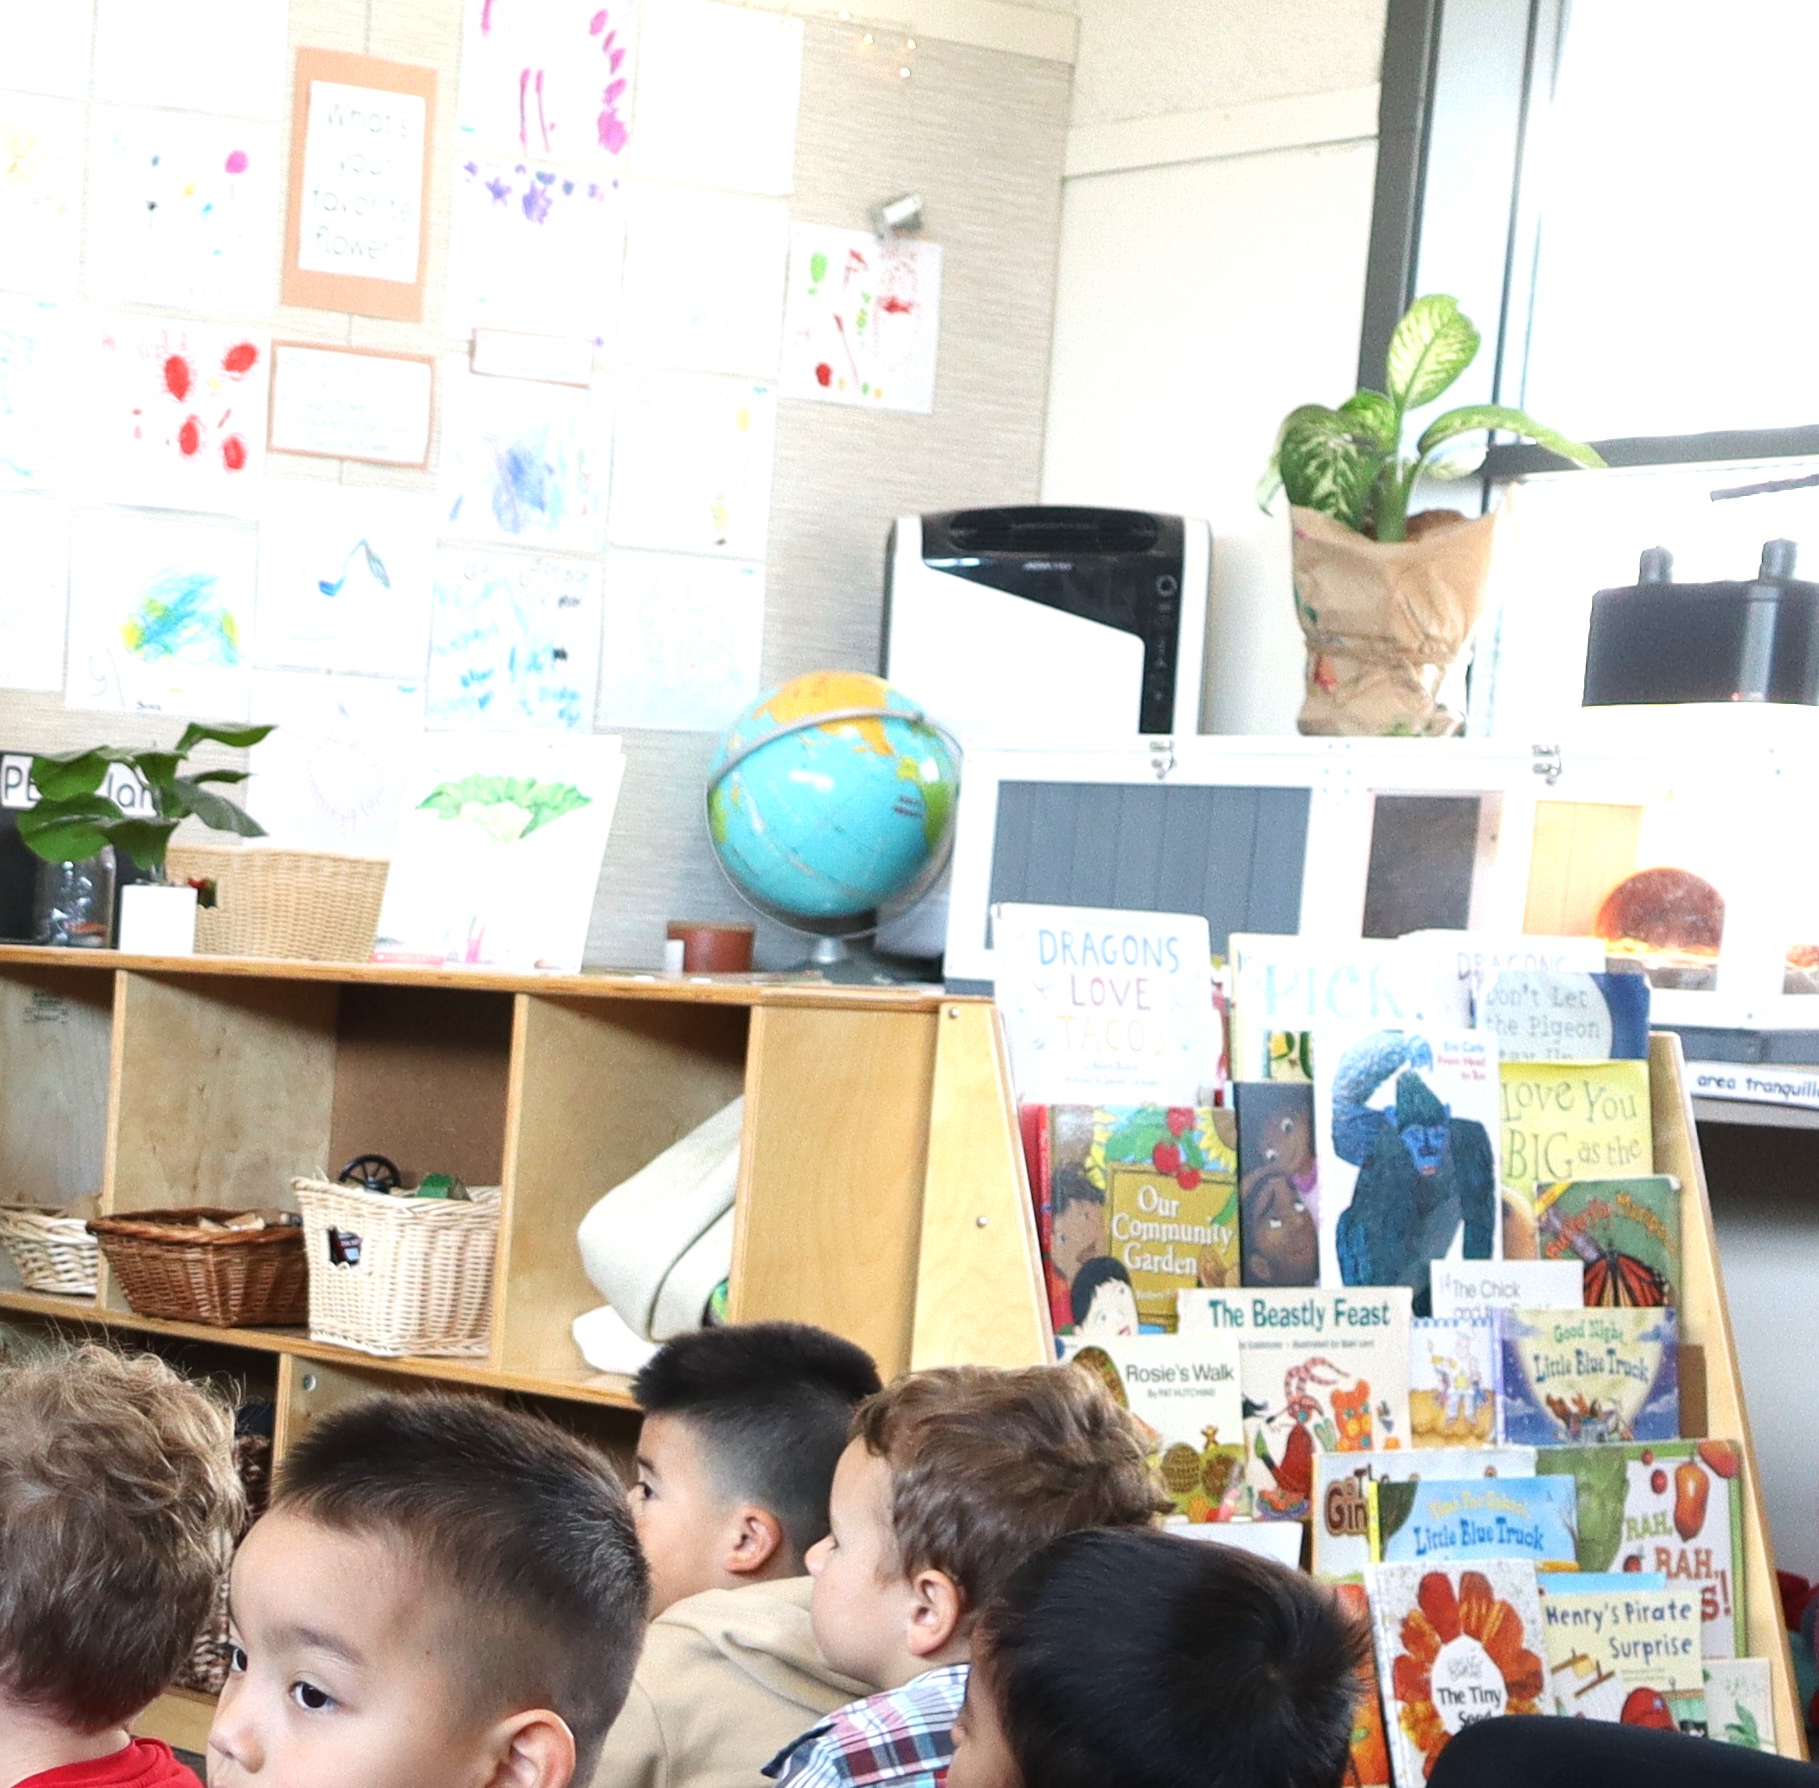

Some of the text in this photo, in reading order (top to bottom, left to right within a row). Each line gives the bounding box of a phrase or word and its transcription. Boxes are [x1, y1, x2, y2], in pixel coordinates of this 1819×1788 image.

[1038, 928, 1180, 974] DRAGONS
[1071, 974, 1151, 1011] LOVE
[1549, 985, 1588, 1008] Let
[1529, 1014, 1601, 1044] Pigeon
[1697, 1074, 1736, 1090] area
[1501, 1079, 1638, 1122] Love You
[1506, 1128, 1642, 1180] BIG as the
[1137, 1186, 1181, 1217] Our
[1112, 1213, 1233, 1252] Community
[1123, 1244, 1198, 1276] Garden
[1452, 1278, 1520, 1299] The Chick
[1209, 1299, 1392, 1332] The Beastly Feast
[1126, 1363, 1235, 1383] Rosie's Walk
[1533, 1347, 1650, 1383] Little Blue Truck
[1413, 1516, 1544, 1556] Little Blue Truck
[1546, 1600, 1692, 1632] Henry's Pirate
[1609, 1635, 1692, 1665] Surprise
[1437, 1685, 1502, 1708] The Tiny
